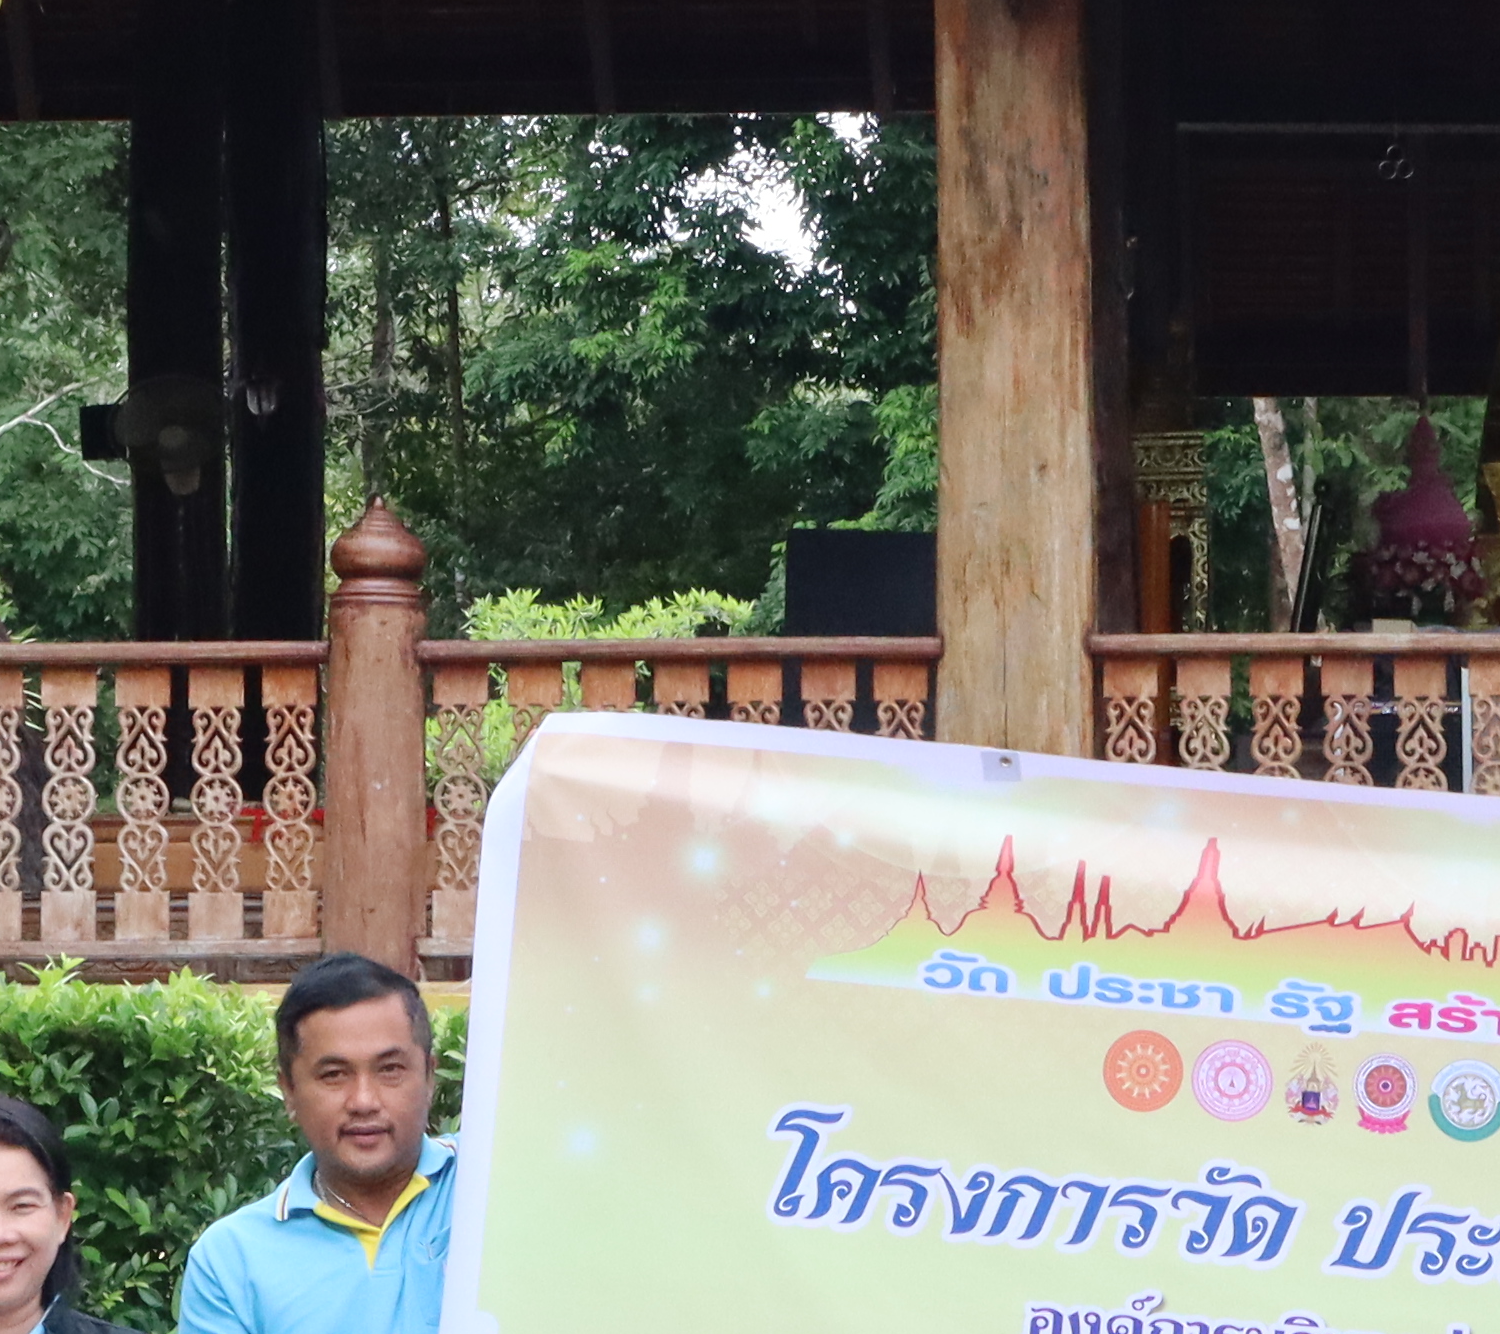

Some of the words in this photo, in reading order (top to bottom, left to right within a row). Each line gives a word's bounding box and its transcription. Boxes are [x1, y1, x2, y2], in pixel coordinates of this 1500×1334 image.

[924, 951, 1007, 991] วัด
[1051, 965, 1234, 1013] ประชา
[1270, 981, 1354, 1034] รัฐ
[773, 1110, 1304, 1264] โครงการวัด
